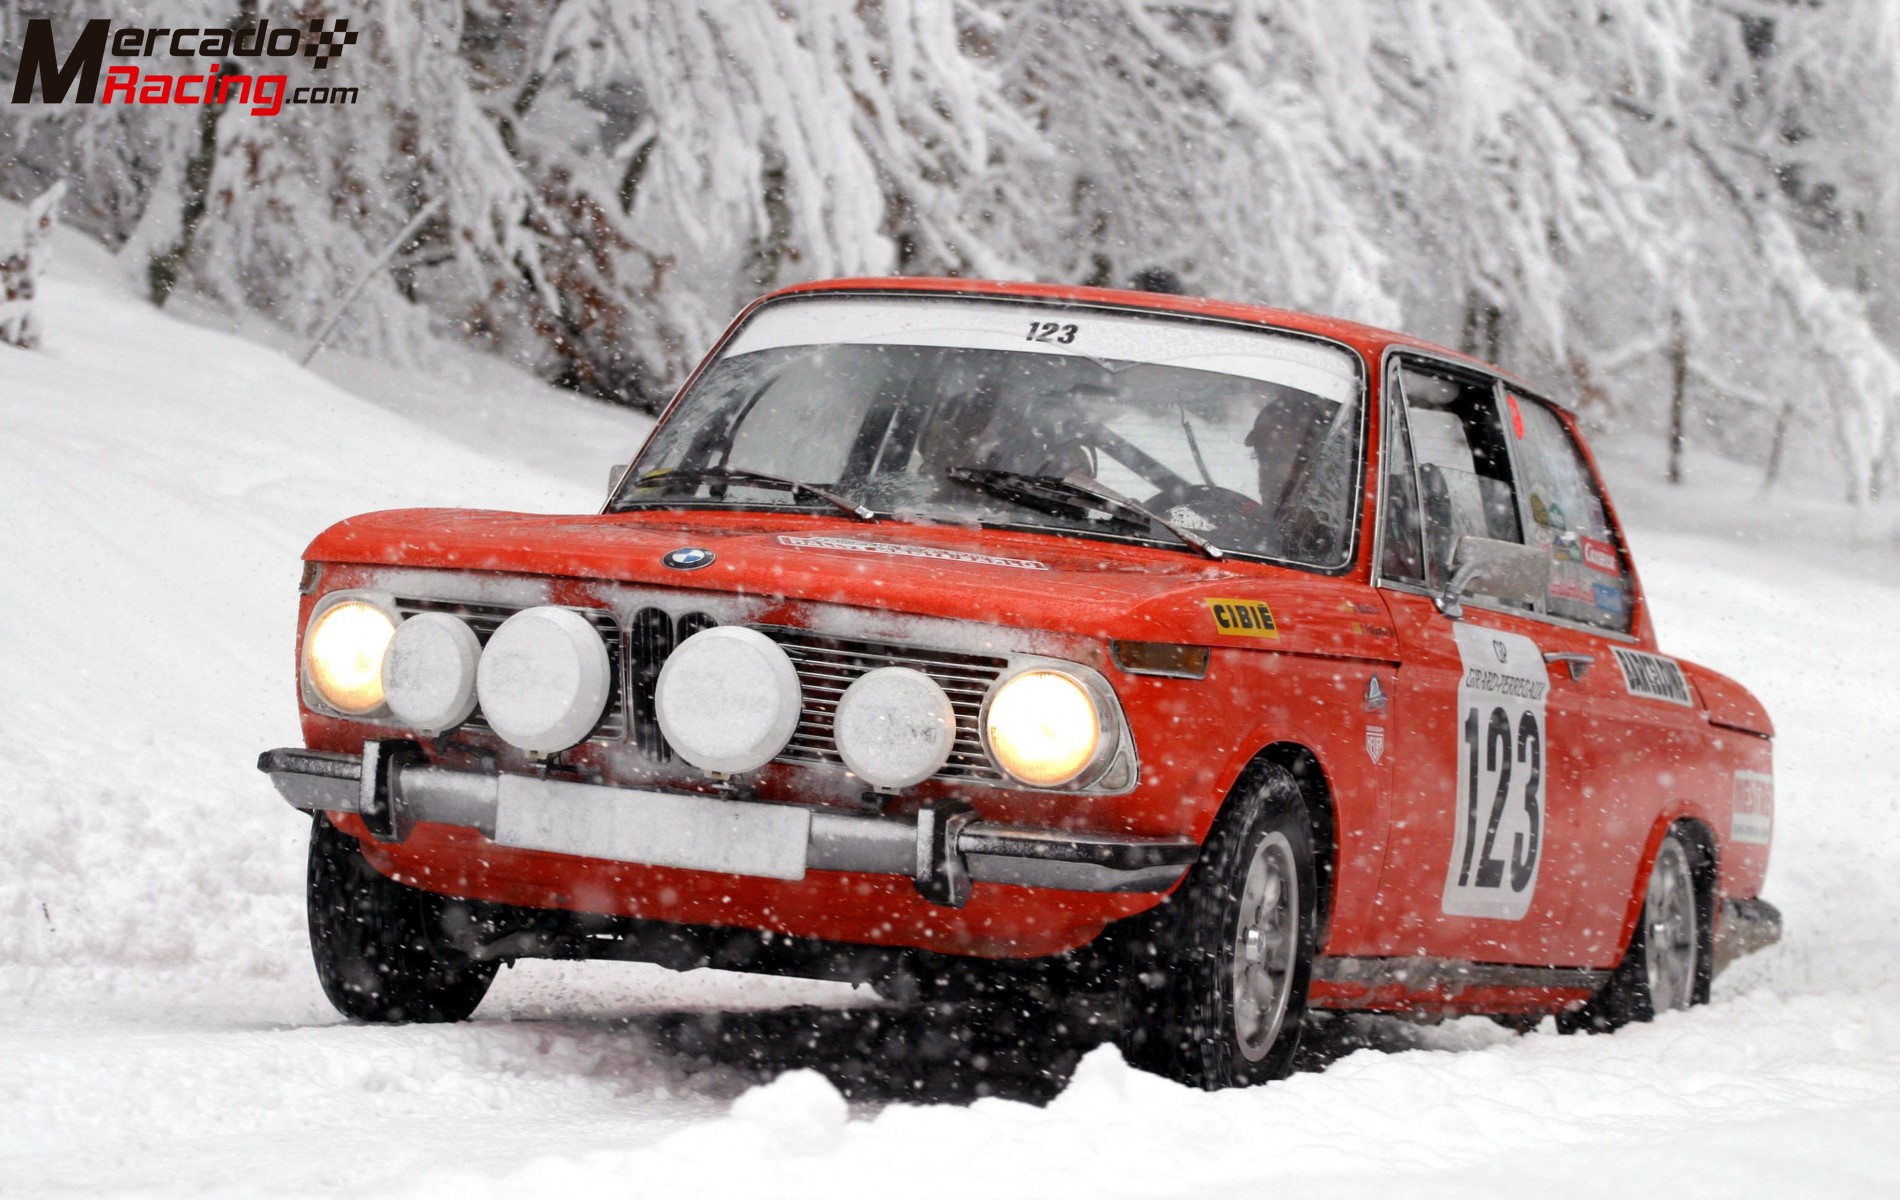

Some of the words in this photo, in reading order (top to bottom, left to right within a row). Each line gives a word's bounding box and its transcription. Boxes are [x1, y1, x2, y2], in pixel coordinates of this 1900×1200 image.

[1025, 321, 1079, 345] 123
[1465, 667, 1547, 702] GIRARD-PERREGAUX
[1457, 706, 1541, 893] 123
